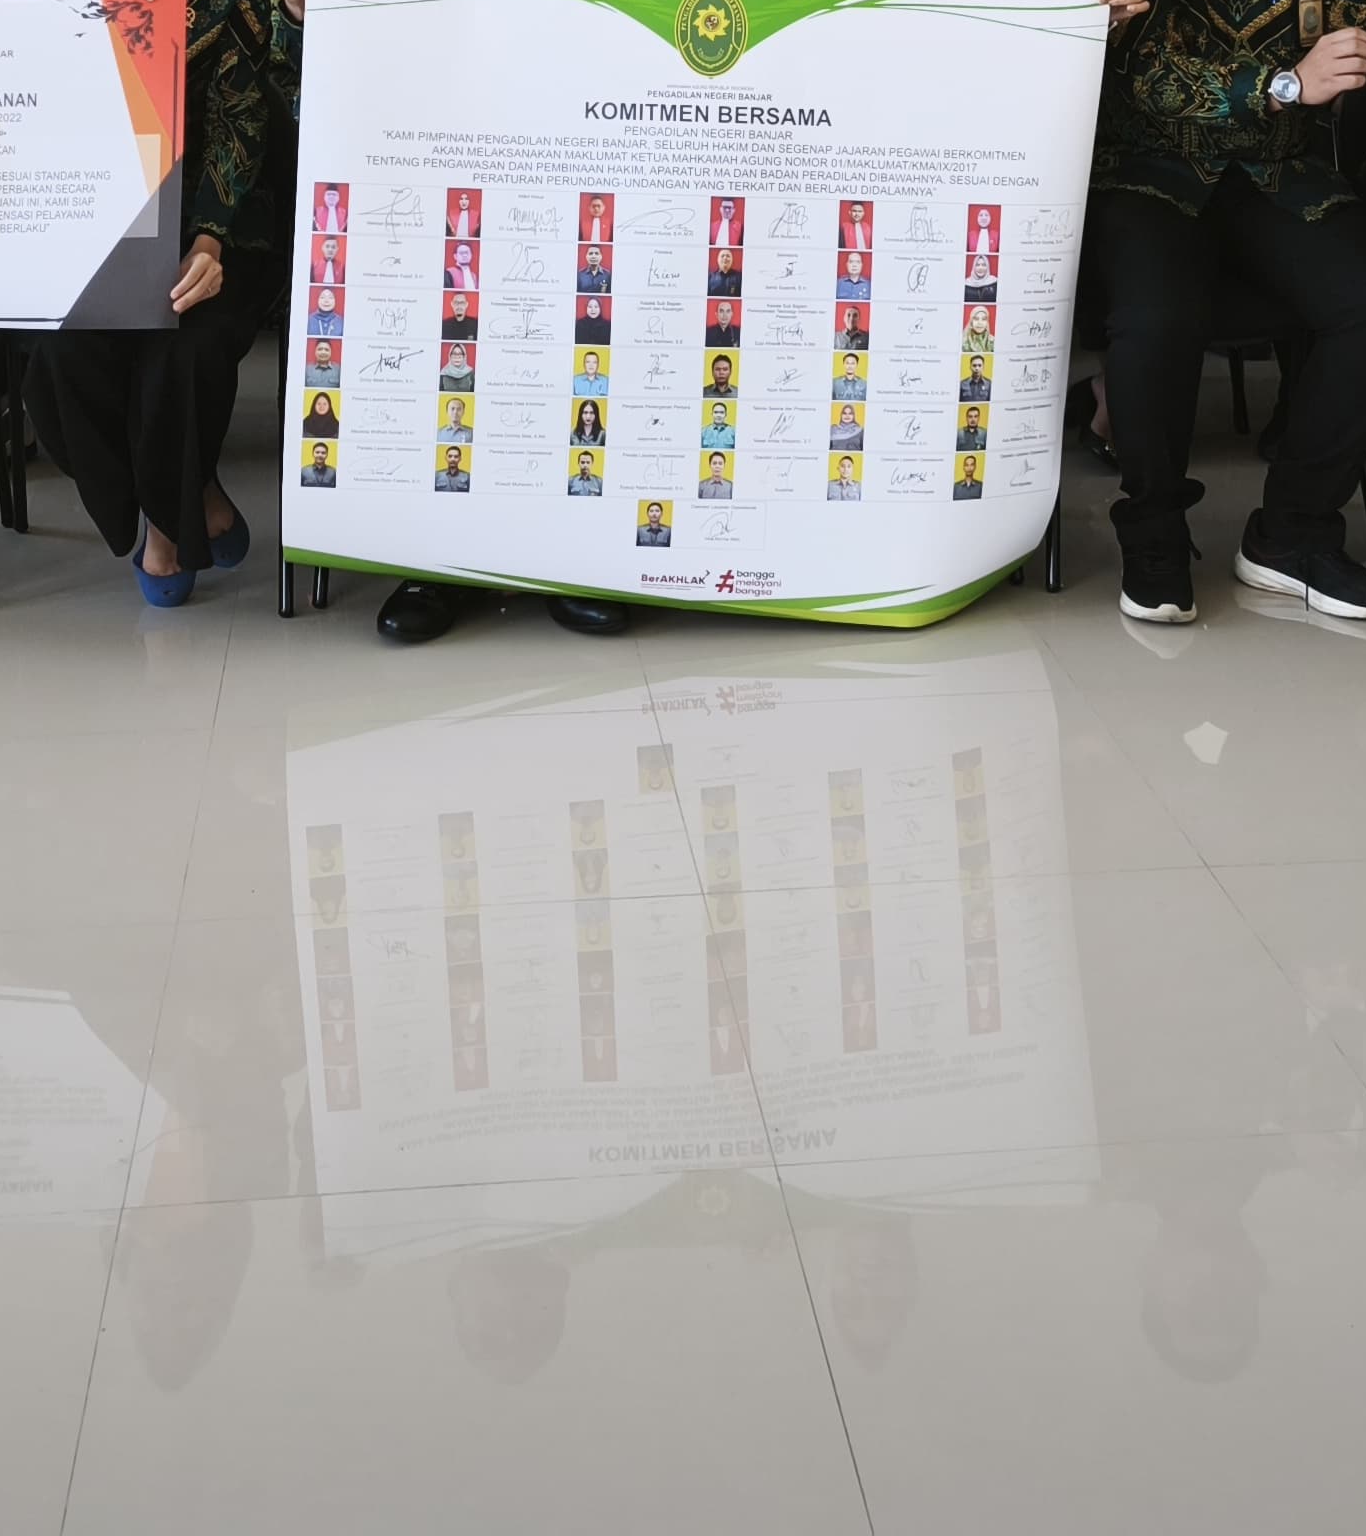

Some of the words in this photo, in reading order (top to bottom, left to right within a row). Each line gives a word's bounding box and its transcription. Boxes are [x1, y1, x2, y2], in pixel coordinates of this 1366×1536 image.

[646, 90, 702, 99] PENGADILAN
[703, 92, 736, 100] NEGERI
[737, 93, 772, 101] BANJAR
[584, 101, 709, 124] KOMITMEN
[717, 105, 831, 127] BERSAMA
[623, 126, 698, 138] PENGADILAN
[700, 128, 745, 139] NEGERI
[747, 129, 794, 141] BANJAR
[417, 131, 473, 143] PIMPINAN
[476, 133, 551, 146] PENGADILAN
[554, 135, 599, 147] NEGERI
[653, 138, 709, 151] SELURUH
[711, 140, 750, 152] HAKIM
[749, 142, 775, 153] DAN
[777, 143, 833, 155] SEGENAP
[834, 144, 885, 157] JAJARAN
[888, 146, 940, 159] PEGAWAI
[942, 148, 1026, 161] BERKOMITMEN
[431, 145, 464, 157] AKAN
[466, 146, 561, 160] MELAKSANAKAN
[563, 149, 630, 162] MAKLUMAT
[630, 151, 669, 164] KETUA
[671, 153, 738, 166] MAHKAMAH
[739, 155, 782, 167] AGUNG
[784, 156, 828, 168] NOMOR
[829, 158, 977, 173] 01/MAKLUMAT/KMA/IX/2017
[33, 170, 81, 181] STANDAR
[83, 170, 112, 181] YANG
[366, 155, 419, 167] TENTANG
[422, 157, 505, 170] PENGAWASAN
[505, 159, 533, 171] DAN
[533, 160, 606, 173] PEMBINAAN
[648, 164, 712, 177] APARATUR
[712, 166, 731, 177] MA
[732, 167, 757, 178] DAN
[759, 168, 799, 179] BADAN
[801, 169, 866, 182] PERADILAN
[948, 174, 990, 186] SESUAI
[990, 175, 1039, 187] DENGAN
[54, 183, 96, 194] SECARA
[471, 173, 543, 186] PERATURAN
[546, 175, 690, 190] PERUNDANG-UNDANGAN
[692, 179, 724, 191] YANG
[726, 180, 776, 193] TERKAIT
[777, 182, 801, 193] DAN
[804, 183, 859, 195] BERLAKU
[35, 209, 95, 221] PELAYANAN
[641, 573, 706, 585] BerAKHLAK
[736, 569, 775, 580] bangga
[735, 579, 782, 588] melayani
[735, 587, 773, 597] bangsa
